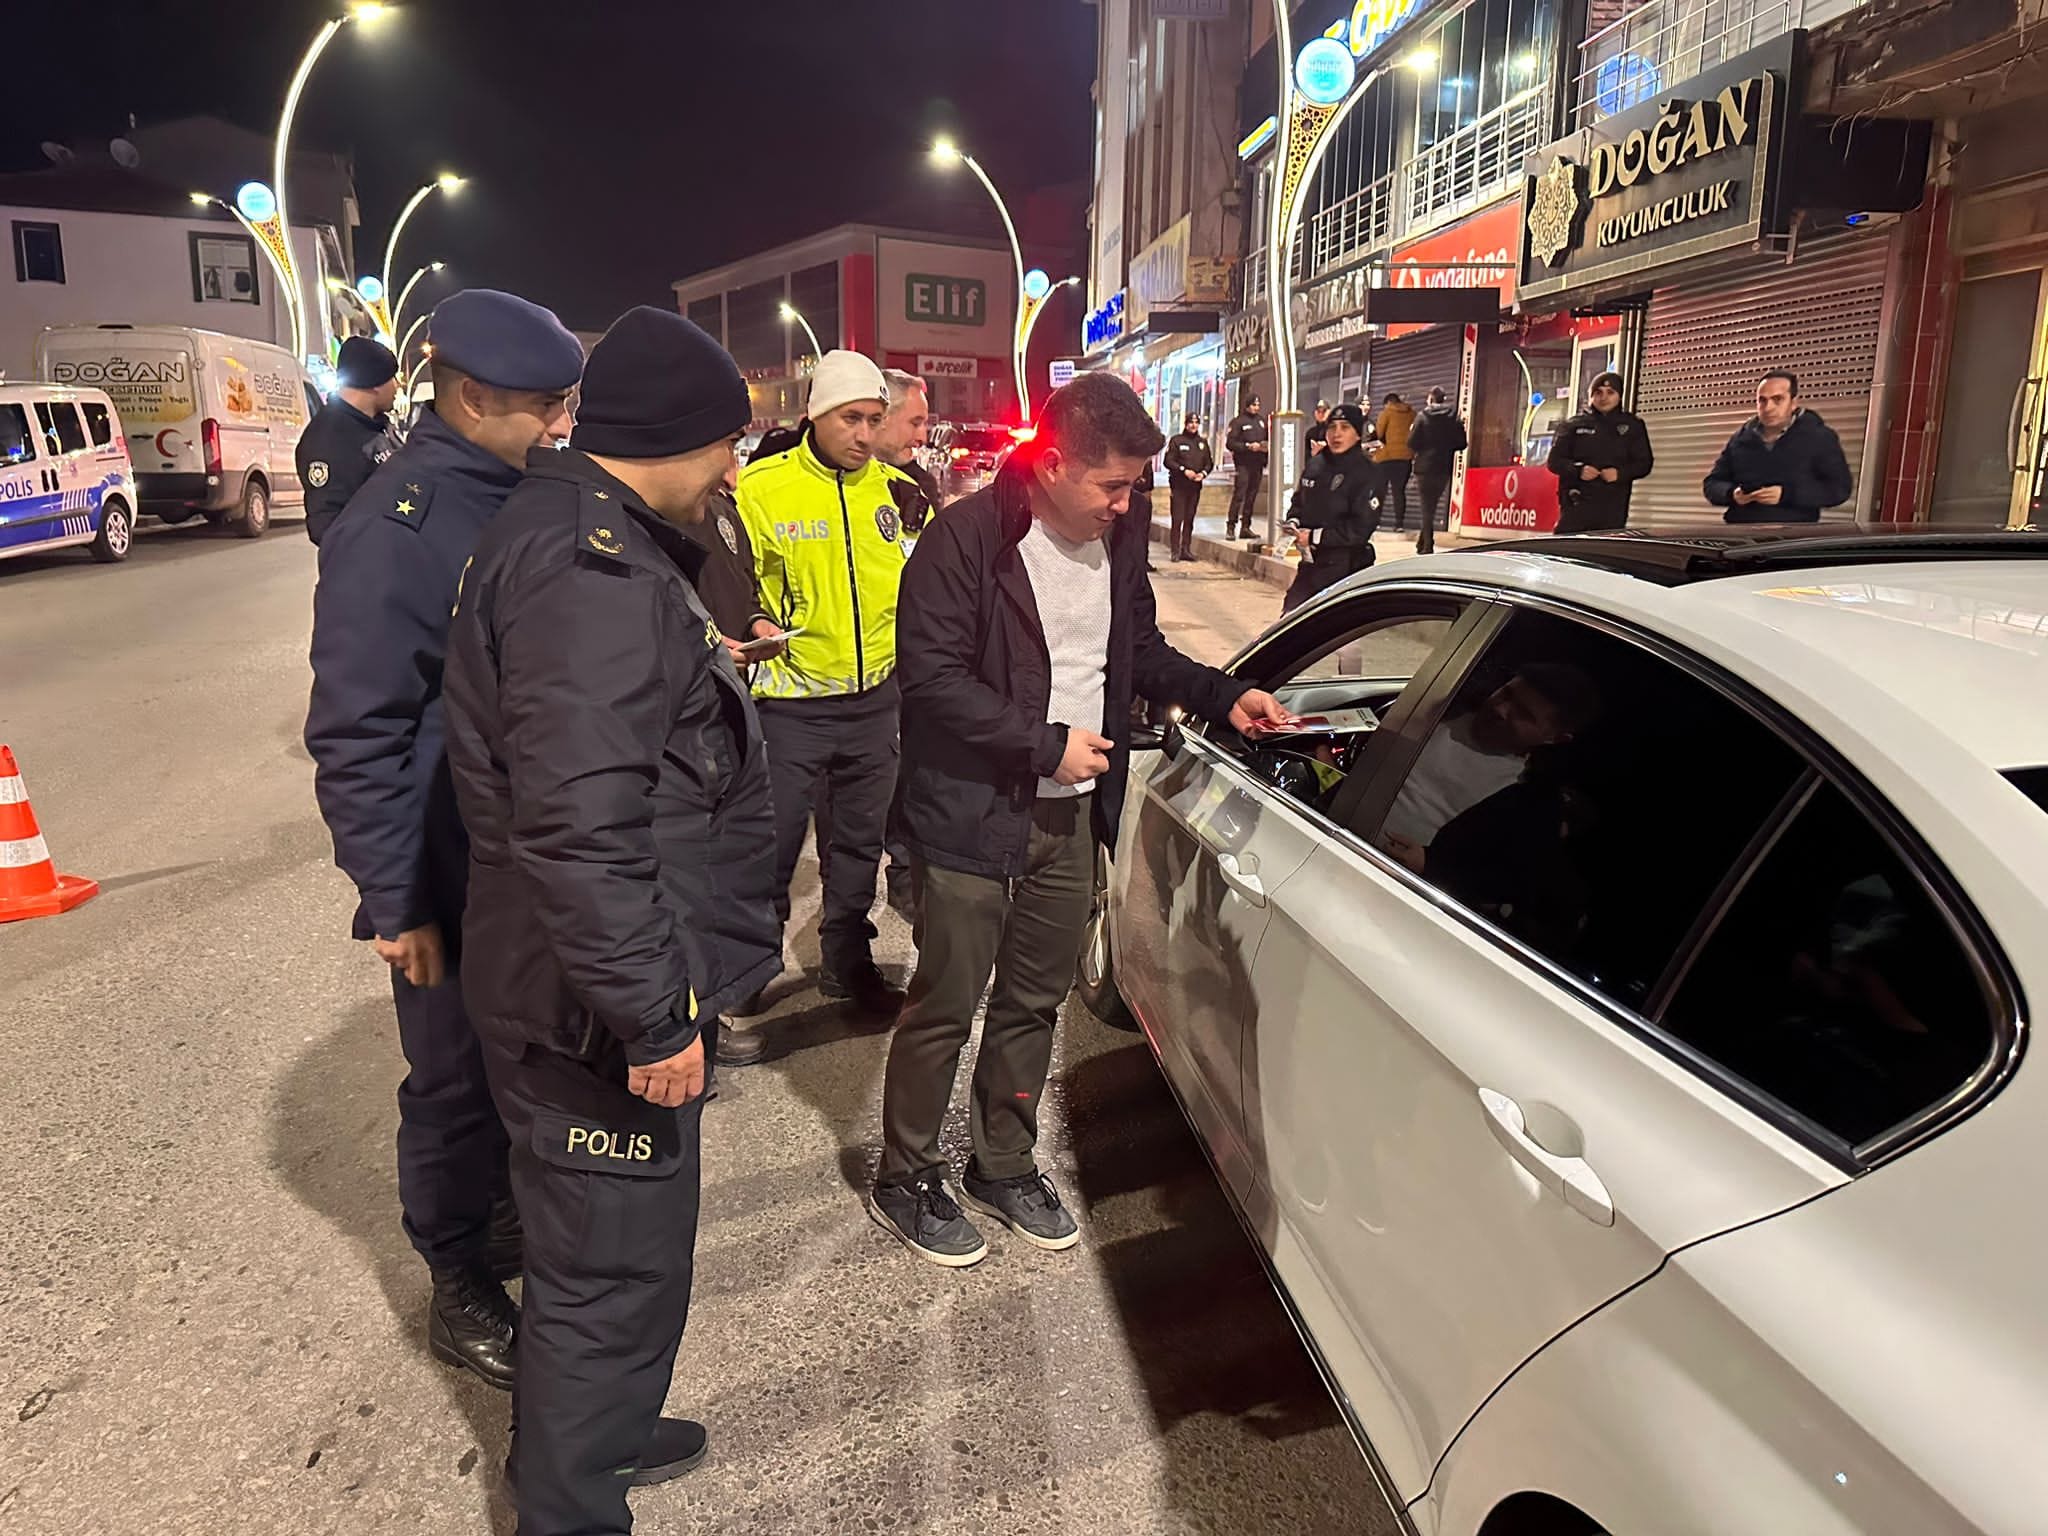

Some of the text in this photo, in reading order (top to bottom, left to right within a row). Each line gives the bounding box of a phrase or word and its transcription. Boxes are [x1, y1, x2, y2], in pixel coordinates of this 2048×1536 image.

[1589, 78, 1753, 199] DOĞAN
[1597, 179, 1731, 248] KUYUMCULUK
[912, 281, 979, 318] Elif
[54, 357, 185, 382] DOĞAN
[1480, 502, 1537, 527] vodafone
